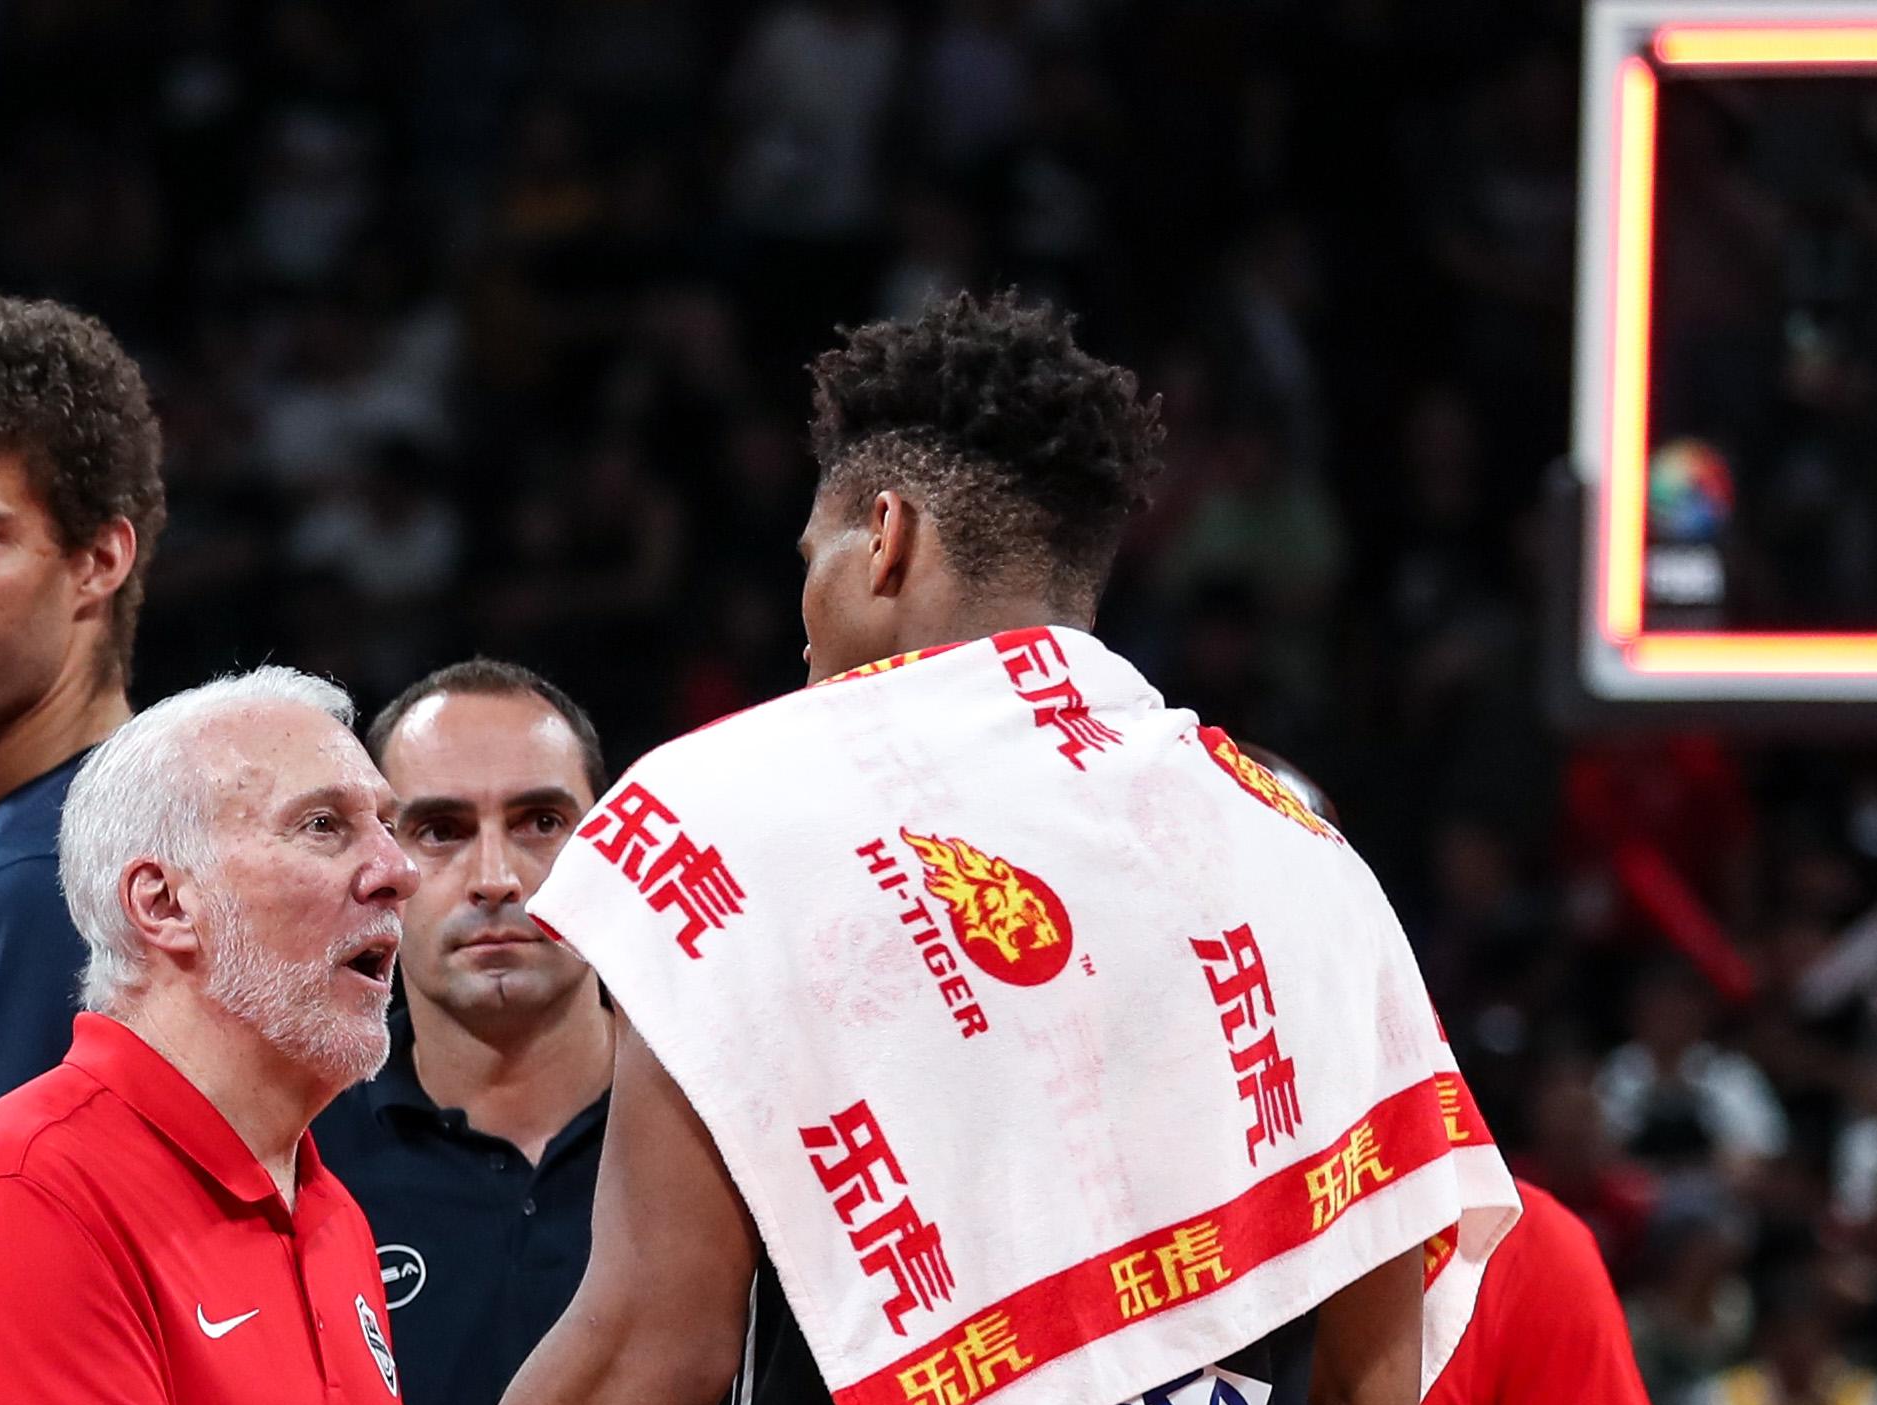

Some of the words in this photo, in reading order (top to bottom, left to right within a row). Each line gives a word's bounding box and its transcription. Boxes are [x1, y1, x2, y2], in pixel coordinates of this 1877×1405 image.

[576, 781, 747, 960] 乐虎
[855, 838, 989, 1039] HI-TIGER
[1078, 953, 1097, 977] TM
[1188, 922, 1303, 1168] 乐虎
[798, 1098, 956, 1337] 乐虎
[1305, 1120, 1394, 1231] 乐虎
[1110, 1219, 1233, 1319] 乐虎
